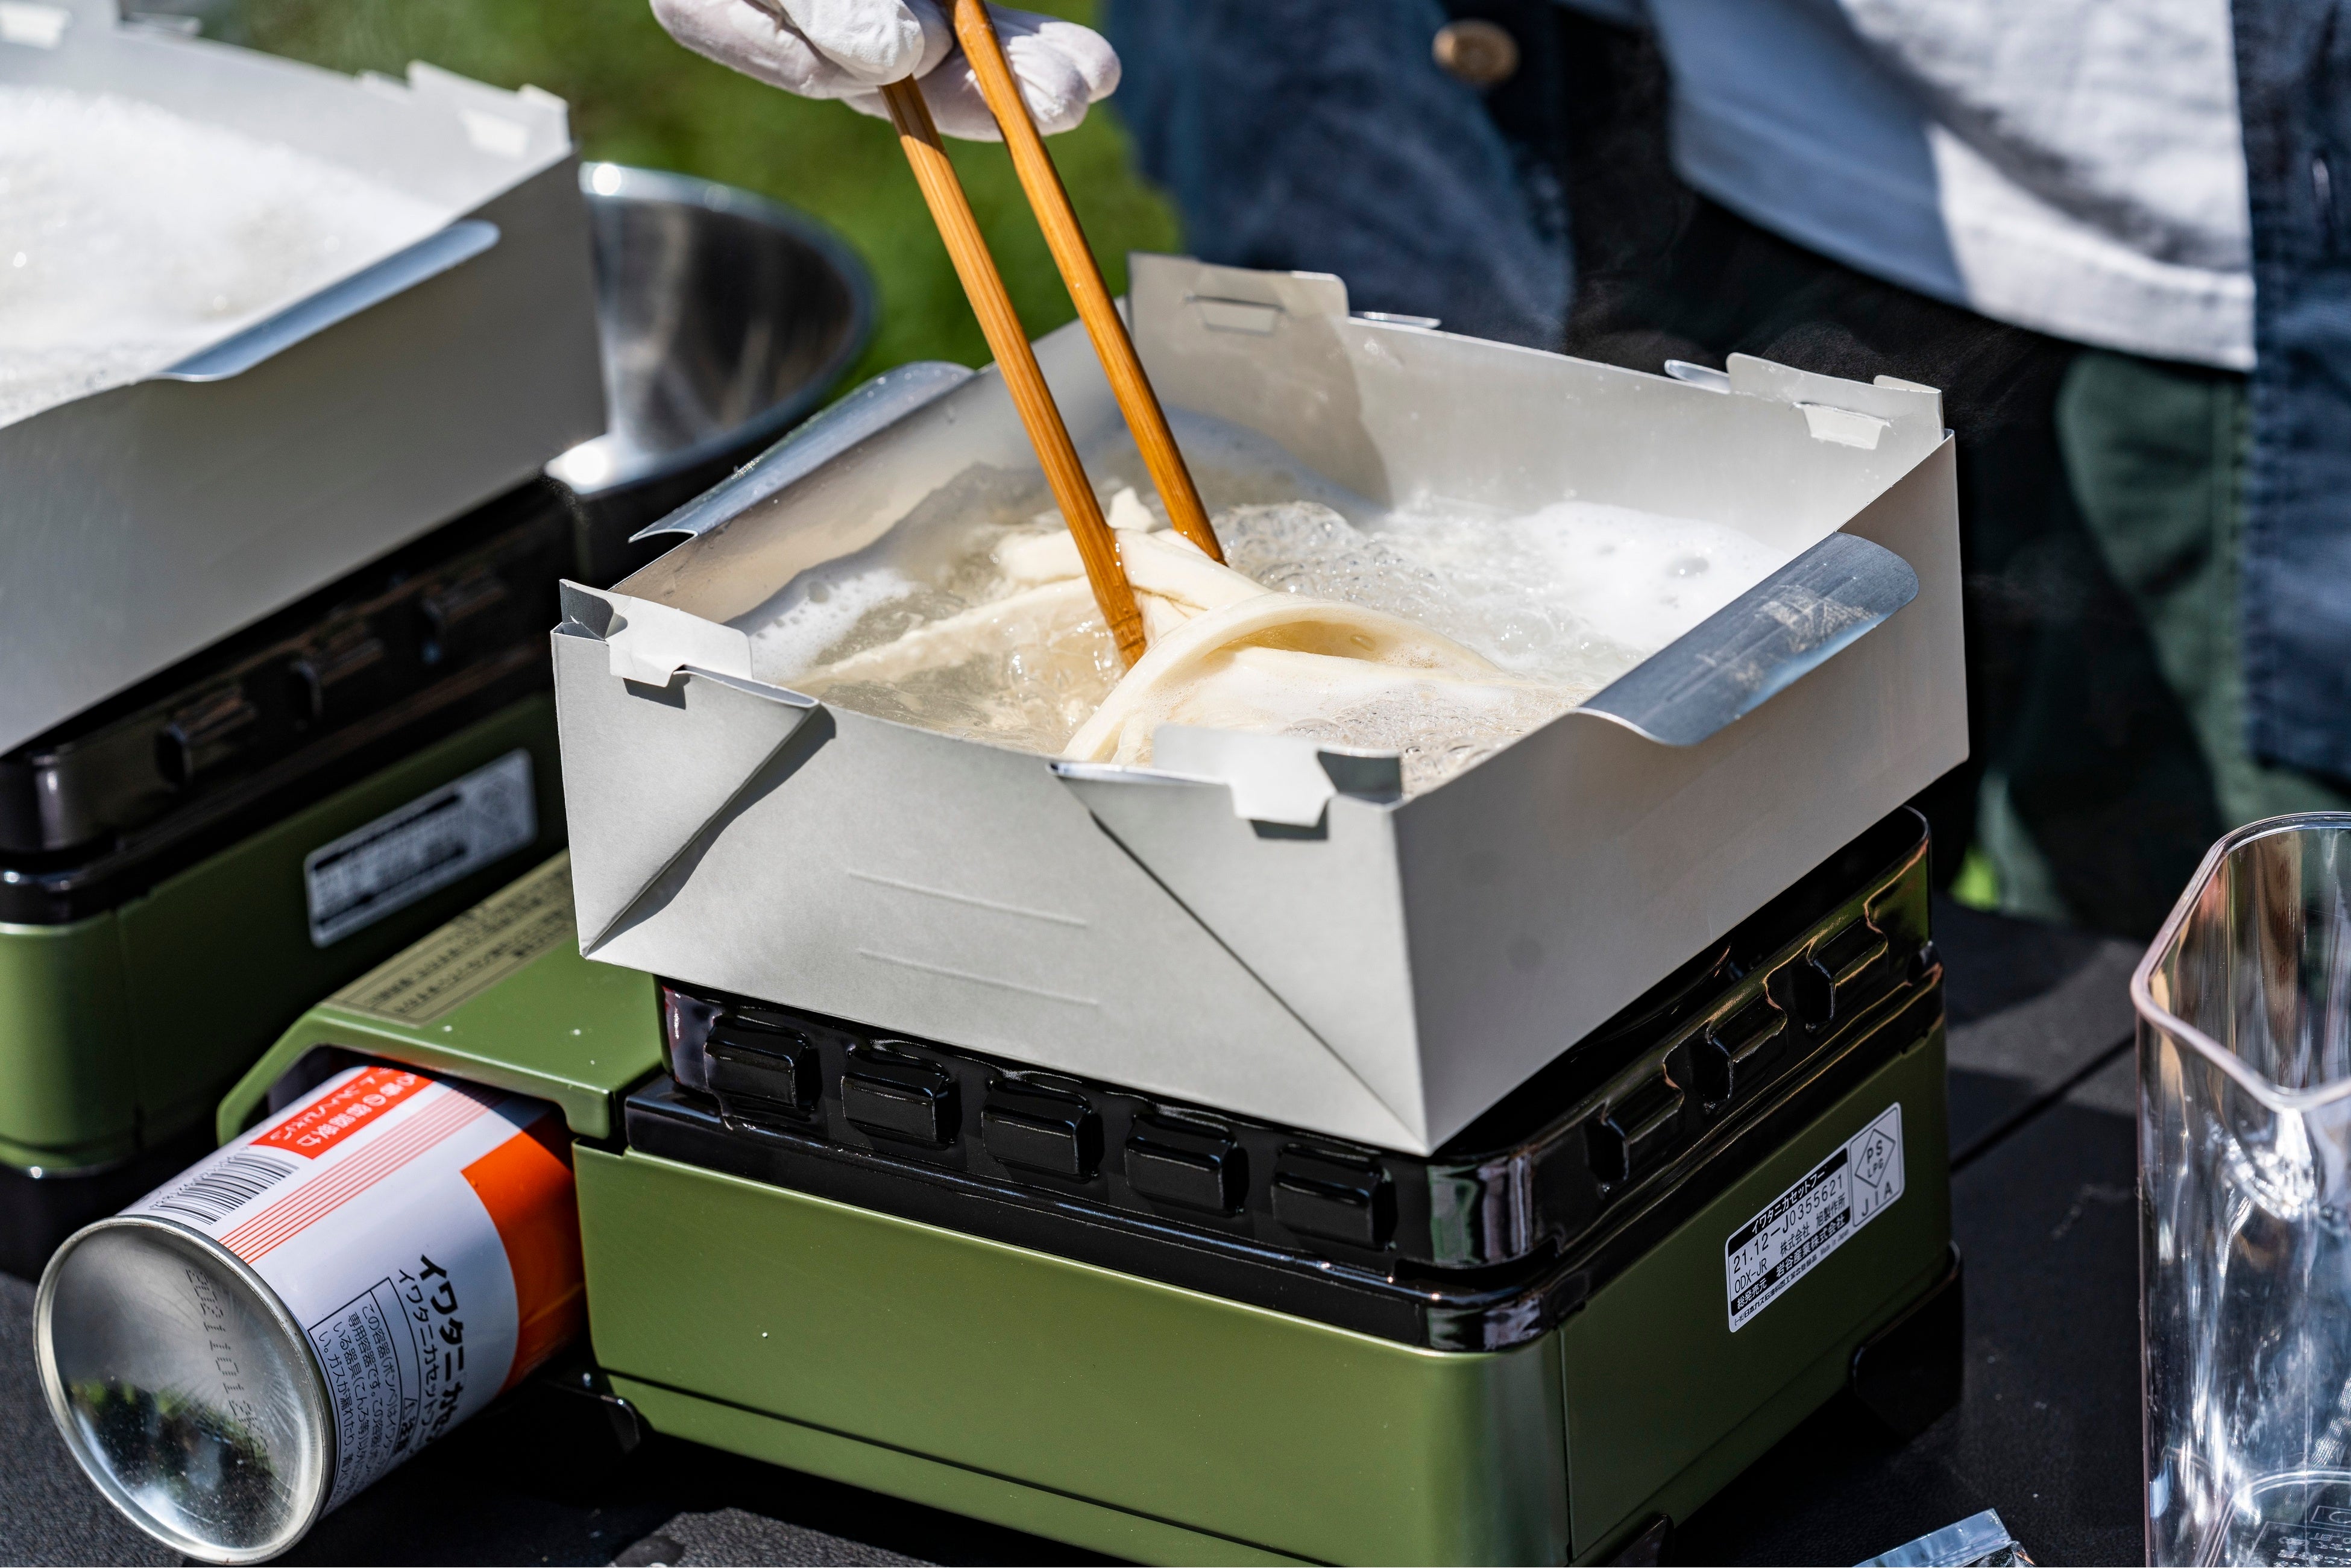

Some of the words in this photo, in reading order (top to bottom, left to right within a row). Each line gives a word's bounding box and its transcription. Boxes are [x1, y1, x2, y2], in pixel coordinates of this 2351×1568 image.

[1867, 1139, 1883, 1163] PS
[1862, 1181, 1893, 1217] JIA
[1780, 1221, 1810, 1257] 株式会社
[1816, 1197, 1845, 1228] 旭製作所
[1737, 1278, 1767, 1309] 総発売元
[1777, 1215, 1846, 1279] 岩谷産業株式会社
